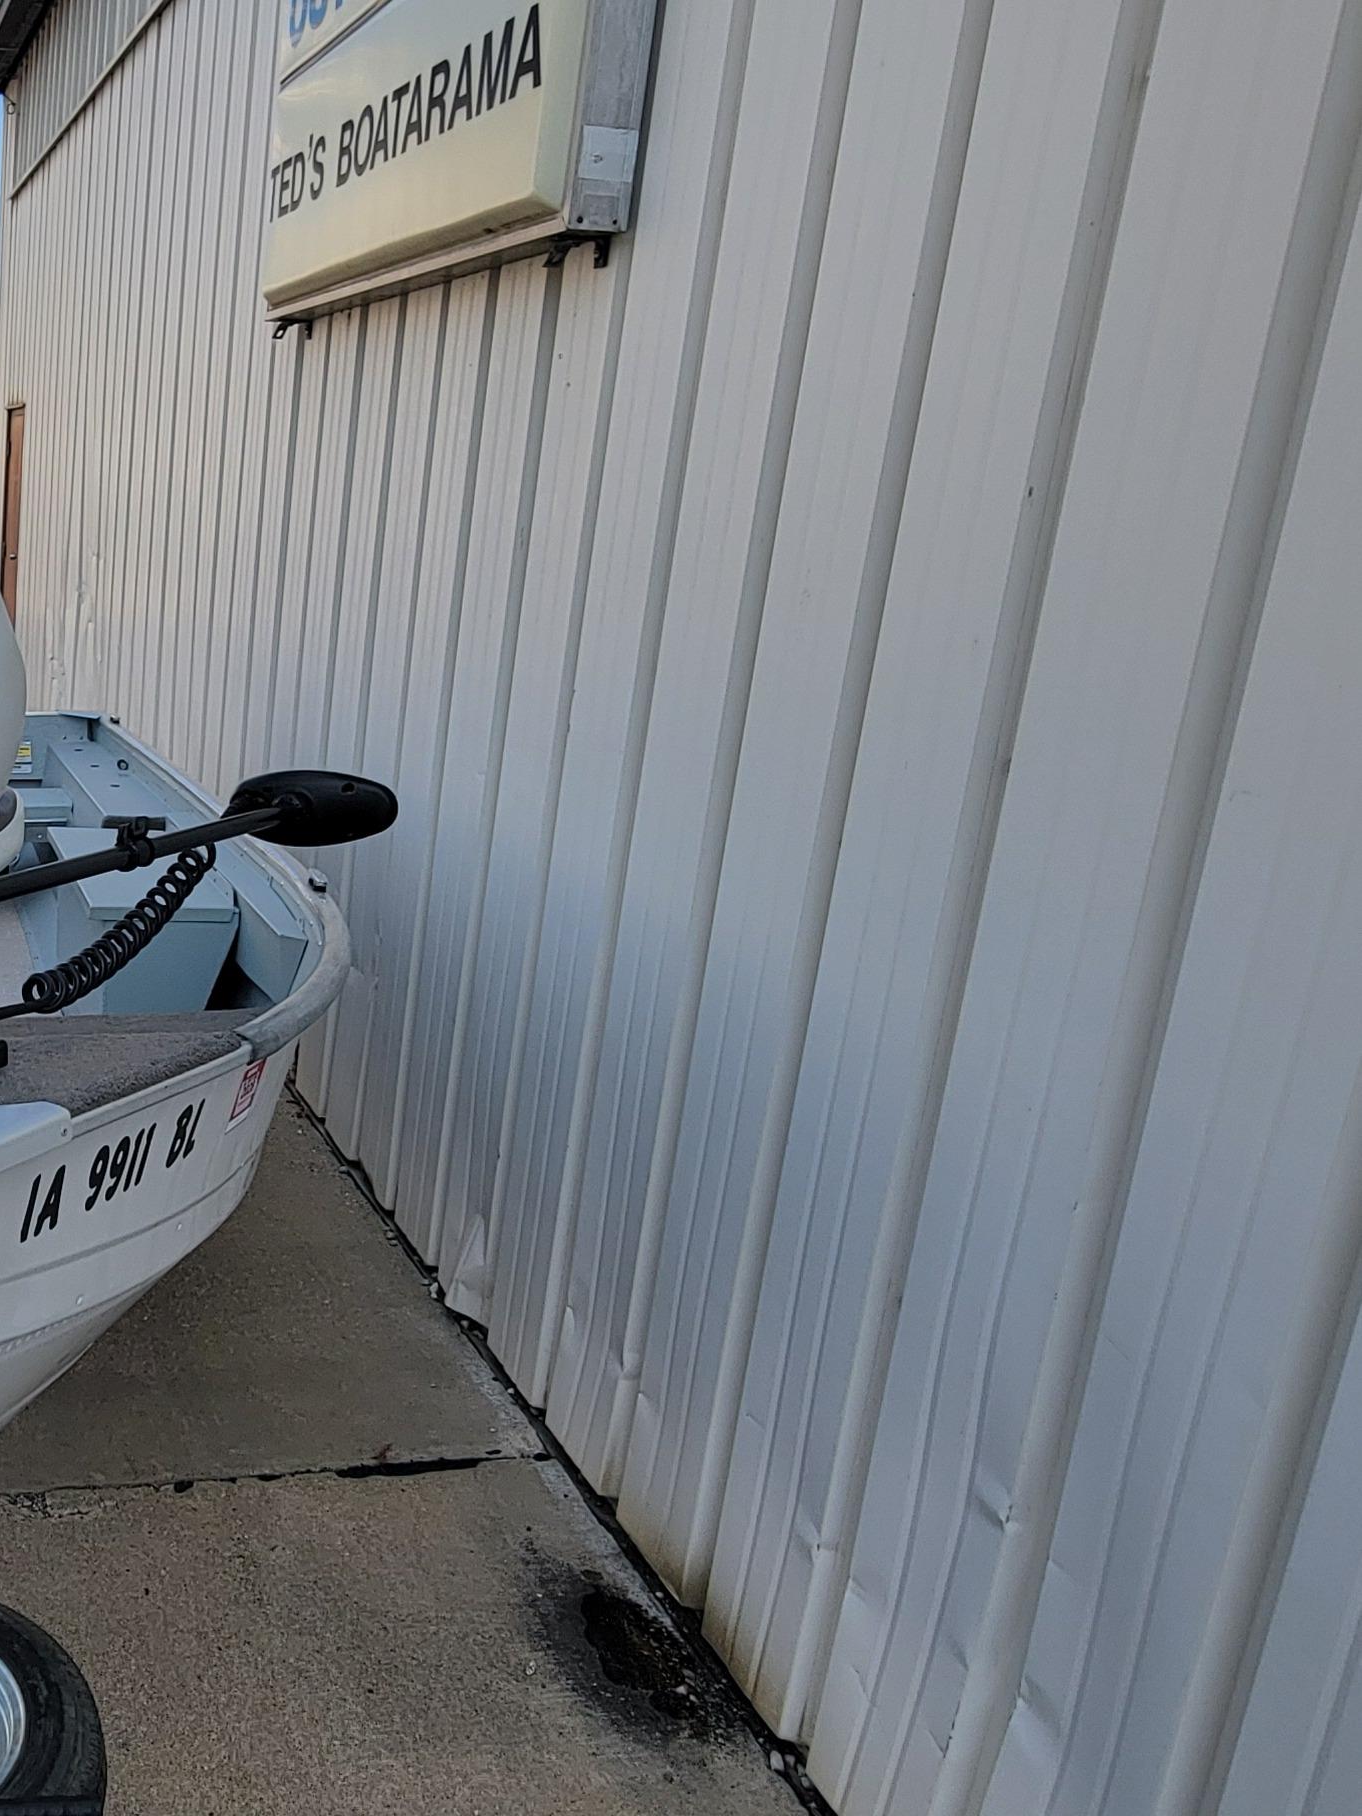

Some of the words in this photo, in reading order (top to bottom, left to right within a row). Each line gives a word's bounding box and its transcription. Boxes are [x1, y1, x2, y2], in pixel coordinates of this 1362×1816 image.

[269, 133, 326, 224] TED'S
[336, 4, 542, 188] BOATARAMA
[20, 1164, 66, 1243] IA
[84, 1123, 156, 1211] 9911
